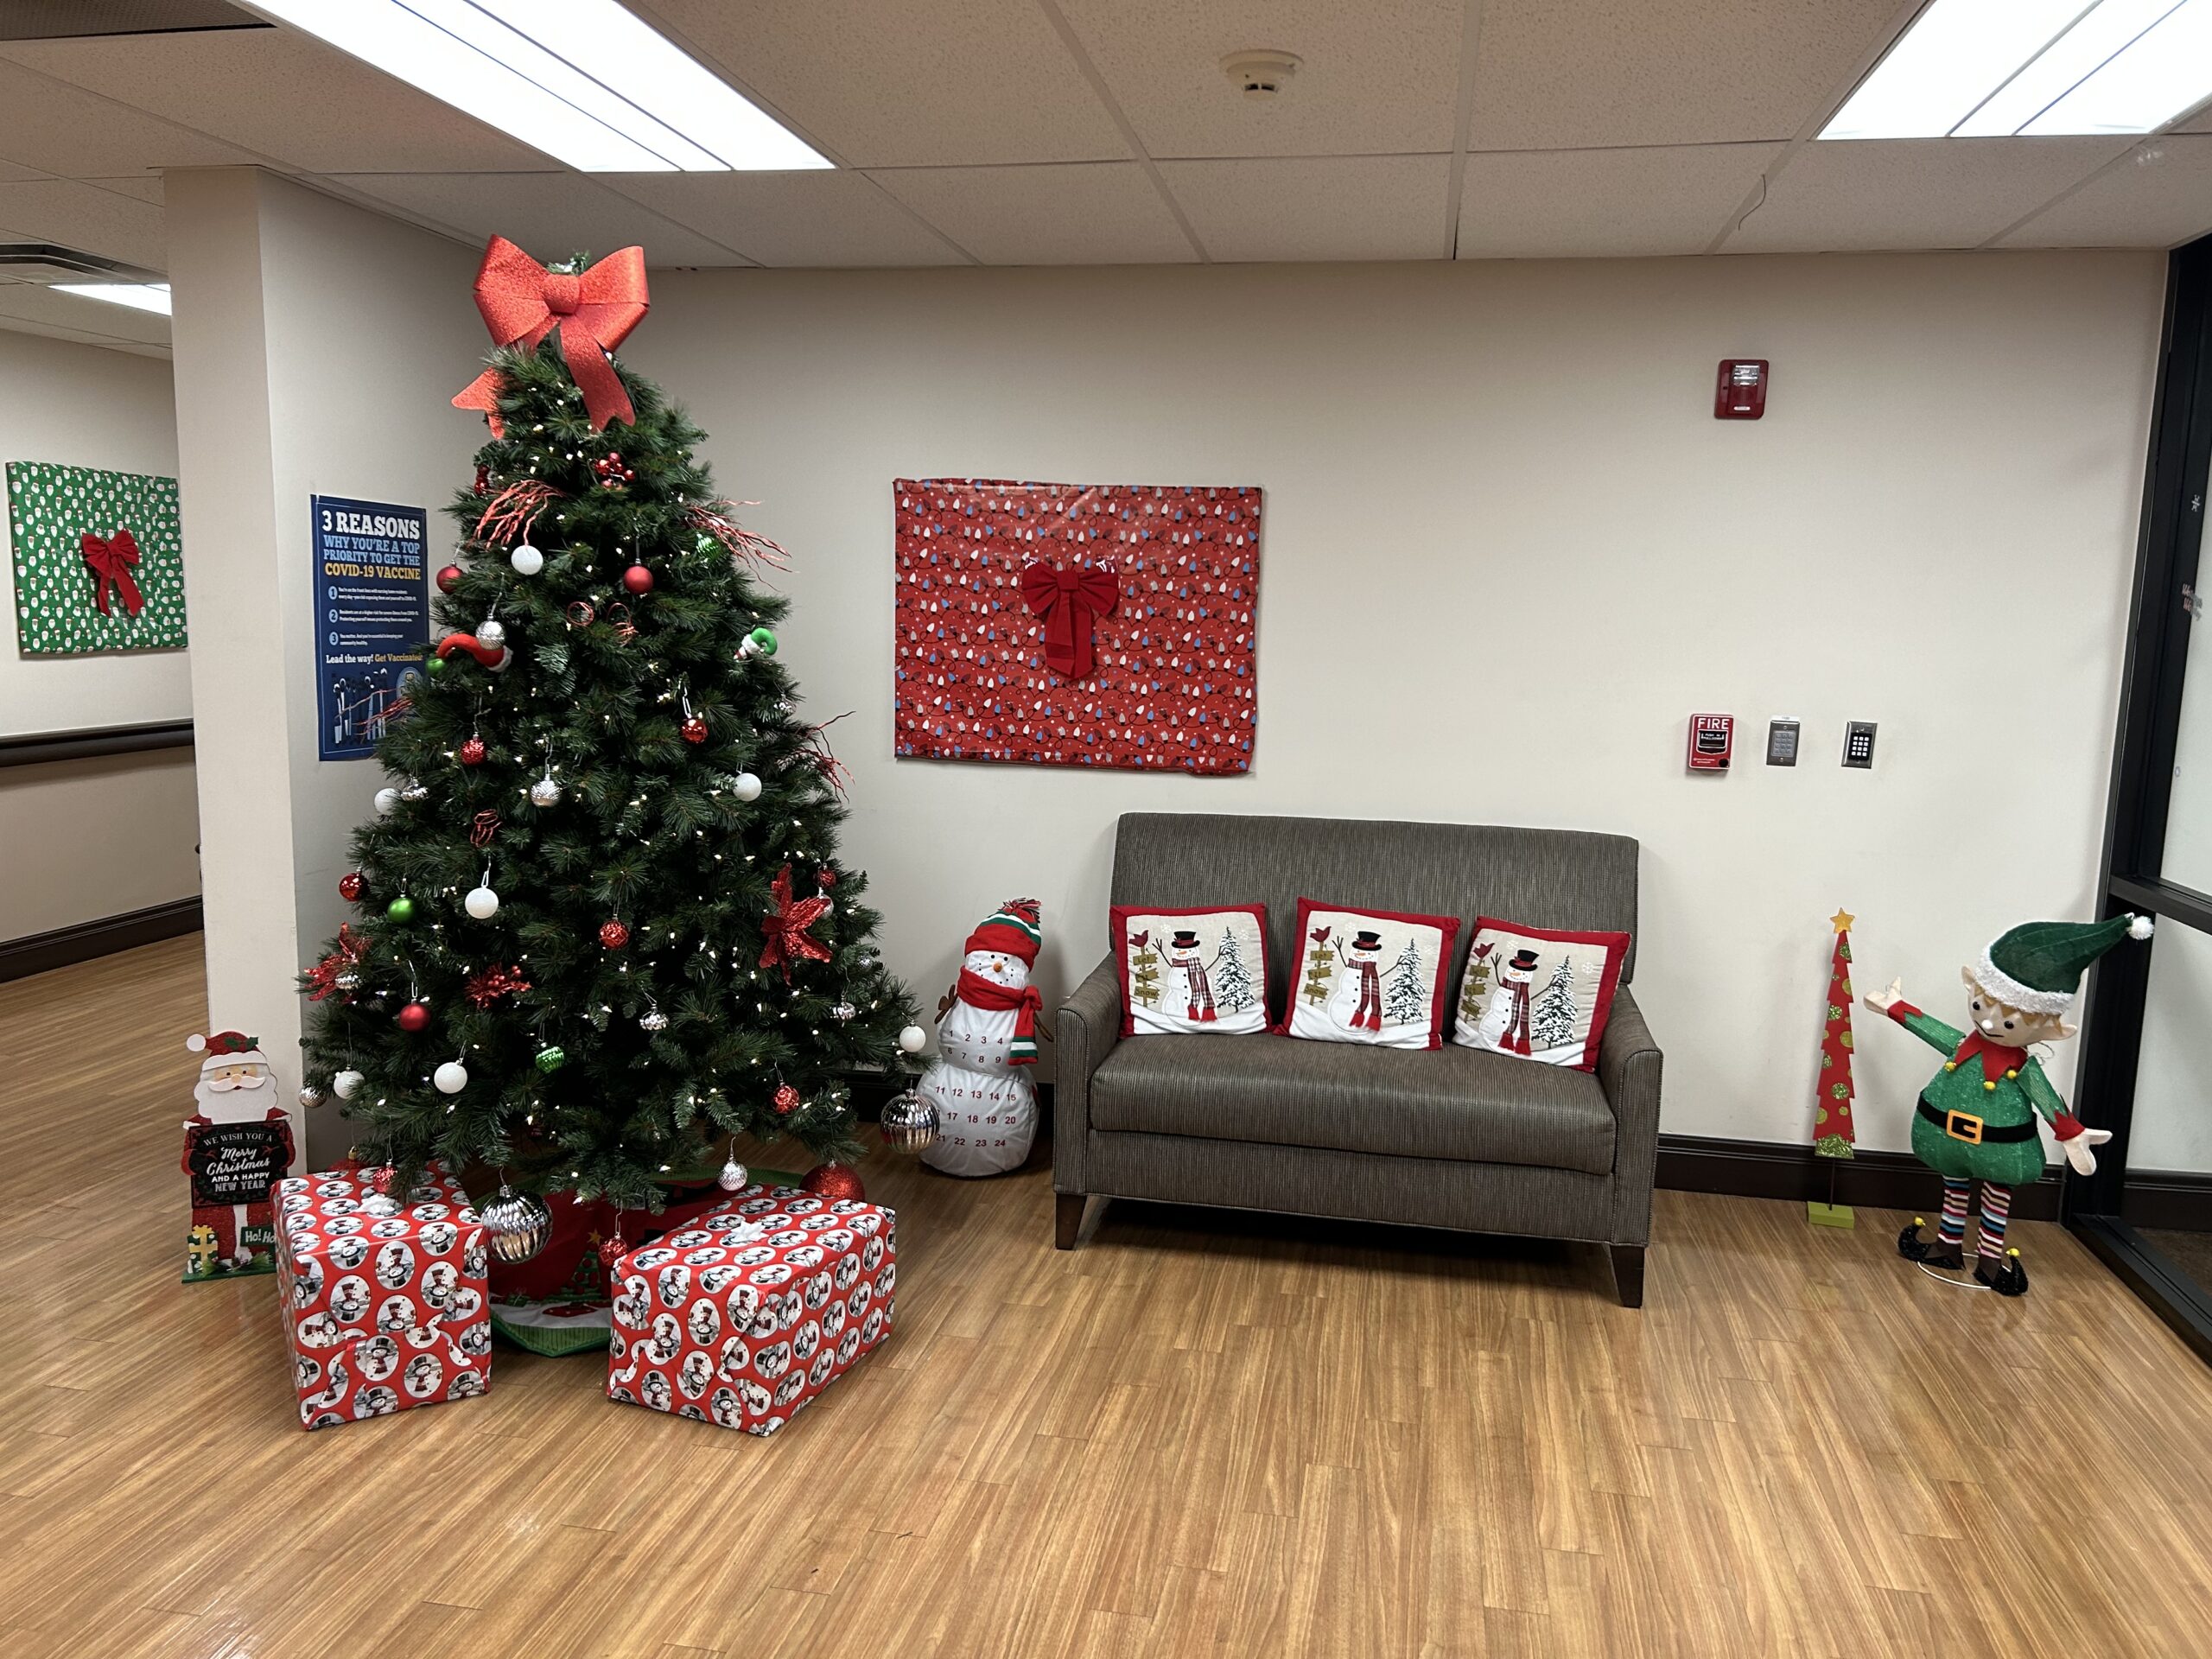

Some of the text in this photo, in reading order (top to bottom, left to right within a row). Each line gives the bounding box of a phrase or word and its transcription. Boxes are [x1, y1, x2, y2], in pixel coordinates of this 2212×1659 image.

[322, 510, 420, 540] 3 REASONS
[323, 535, 420, 554] WHY YOU'RE A TOP
[323, 549, 421, 566] PRIORITY TO GET THE
[325, 563, 421, 581] COVID-19 VACCINE
[326, 654, 344, 664] Lead
[344, 654, 357, 664] the
[357, 654, 374, 664] way!
[374, 654, 386, 663] Get
[1698, 718, 1730, 729] FIRE
[965, 1033, 971, 1042] 2
[936, 1086, 945, 1095] 11
[952, 1089, 963, 1097] 12
[970, 1090, 982, 1099] 13
[989, 1092, 1000, 1101] 14
[947, 1111, 958, 1121] 17
[967, 1115, 979, 1123] 18
[986, 1116, 997, 1124] 19
[1005, 1116, 1016, 1124] 20
[203, 1136, 219, 1147] WE
[220, 1132, 243, 1142] WISH
[245, 1132, 264, 1141] YOU
[936, 1134, 945, 1142] 21
[954, 1136, 966, 1146] 22
[976, 1139, 987, 1147] 23
[220, 1147, 257, 1161] Merry
[206, 1157, 270, 1176] Christmas
[242, 1172, 270, 1180] HAPPY
[215, 1179, 266, 1192] NEW YEAR
[245, 1228, 262, 1243] Ho!
